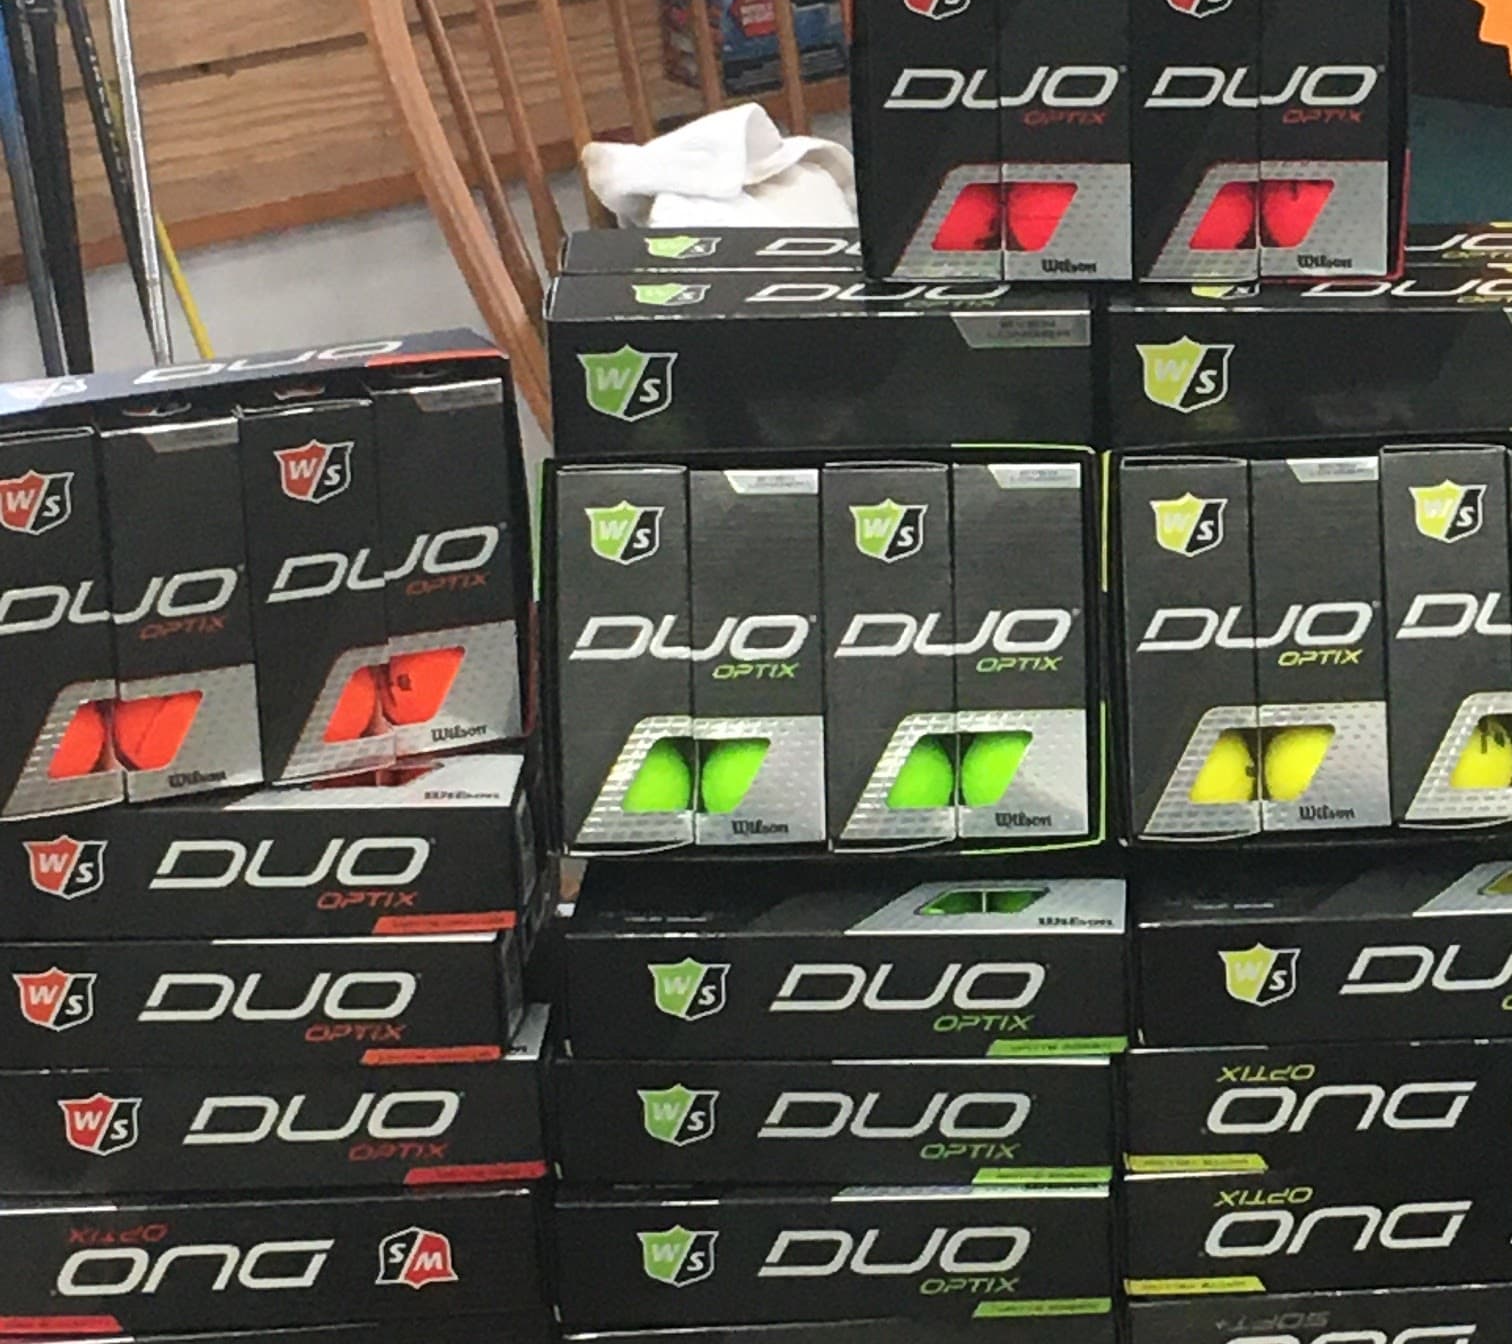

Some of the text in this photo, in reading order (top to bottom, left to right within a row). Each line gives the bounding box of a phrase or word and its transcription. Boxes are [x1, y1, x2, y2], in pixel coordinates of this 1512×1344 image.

[884, 65, 1120, 110] DUO
[1143, 63, 1380, 109] DUO
[1022, 109, 1109, 128] OPTIX
[1280, 107, 1364, 125] OPTIX
[1041, 256, 1097, 274] Wilson
[1298, 253, 1353, 271] Wilson
[134, 340, 403, 384] DUO
[266, 525, 500, 604] DUO
[404, 570, 492, 597] OPTIX
[0, 567, 238, 636] DUO
[138, 615, 227, 641] OPTIX
[568, 613, 811, 661] DUO
[833, 607, 1074, 659] DUO
[1136, 601, 1374, 653] DUO
[975, 654, 1063, 674] OPTIX
[1276, 648, 1363, 667] OPTIX
[711, 660, 800, 680] OPTIX
[431, 722, 488, 743] Wilson
[168, 768, 228, 789] Wilson
[993, 809, 1053, 829] Wilson
[1298, 803, 1356, 824] Wilson
[731, 816, 790, 836] Wilson
[149, 836, 430, 889] DUO
[315, 889, 419, 911] OPTIX
[137, 971, 418, 1022] DUO
[769, 960, 1047, 1012] DUO
[303, 1022, 407, 1043] OPTIX
[932, 1013, 1035, 1033] OPTIX
[1215, 1063, 1316, 1083] OPTIX
[182, 1090, 461, 1145] DUO
[757, 1091, 1033, 1139] DUO
[1206, 1080, 1477, 1134] DUO
[348, 1141, 450, 1162] OPTIX
[919, 1142, 1022, 1161] OPTIX
[1213, 1186, 1314, 1207] OPTIX
[67, 1223, 169, 1244] OPTIX
[1203, 1200, 1473, 1258] DUO
[757, 1225, 1033, 1278] DUO
[56, 1238, 335, 1297] DUO
[919, 1277, 1022, 1296] OPTIX
